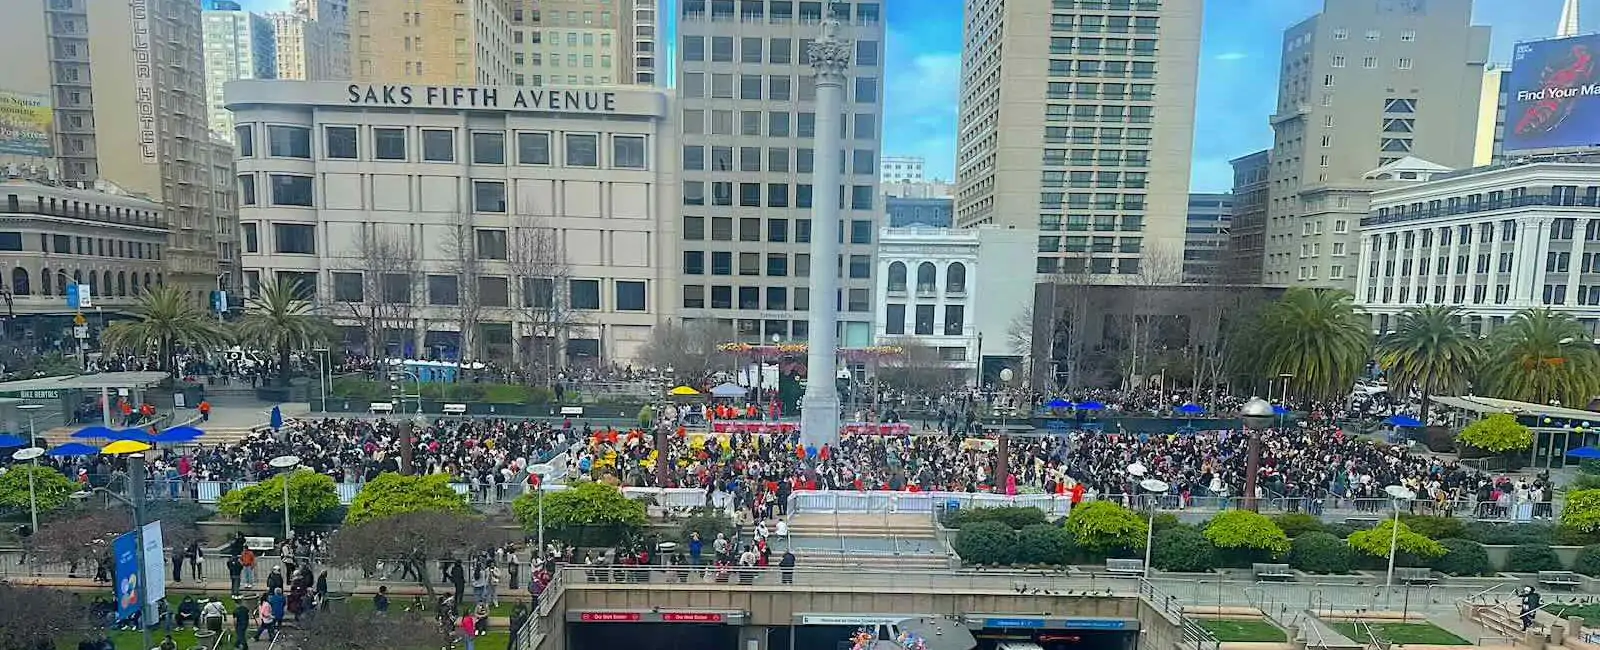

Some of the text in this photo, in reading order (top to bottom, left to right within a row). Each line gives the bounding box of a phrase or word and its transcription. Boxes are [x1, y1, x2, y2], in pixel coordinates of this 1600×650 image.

[348, 84, 616, 111] SAKS FIFTH AVENUE
[1517, 89, 1545, 101] Find
[1548, 87, 1579, 99] Your
[138, 87, 155, 158] HOTEL
[21, 390, 59, 399] BIKE RENTALS
